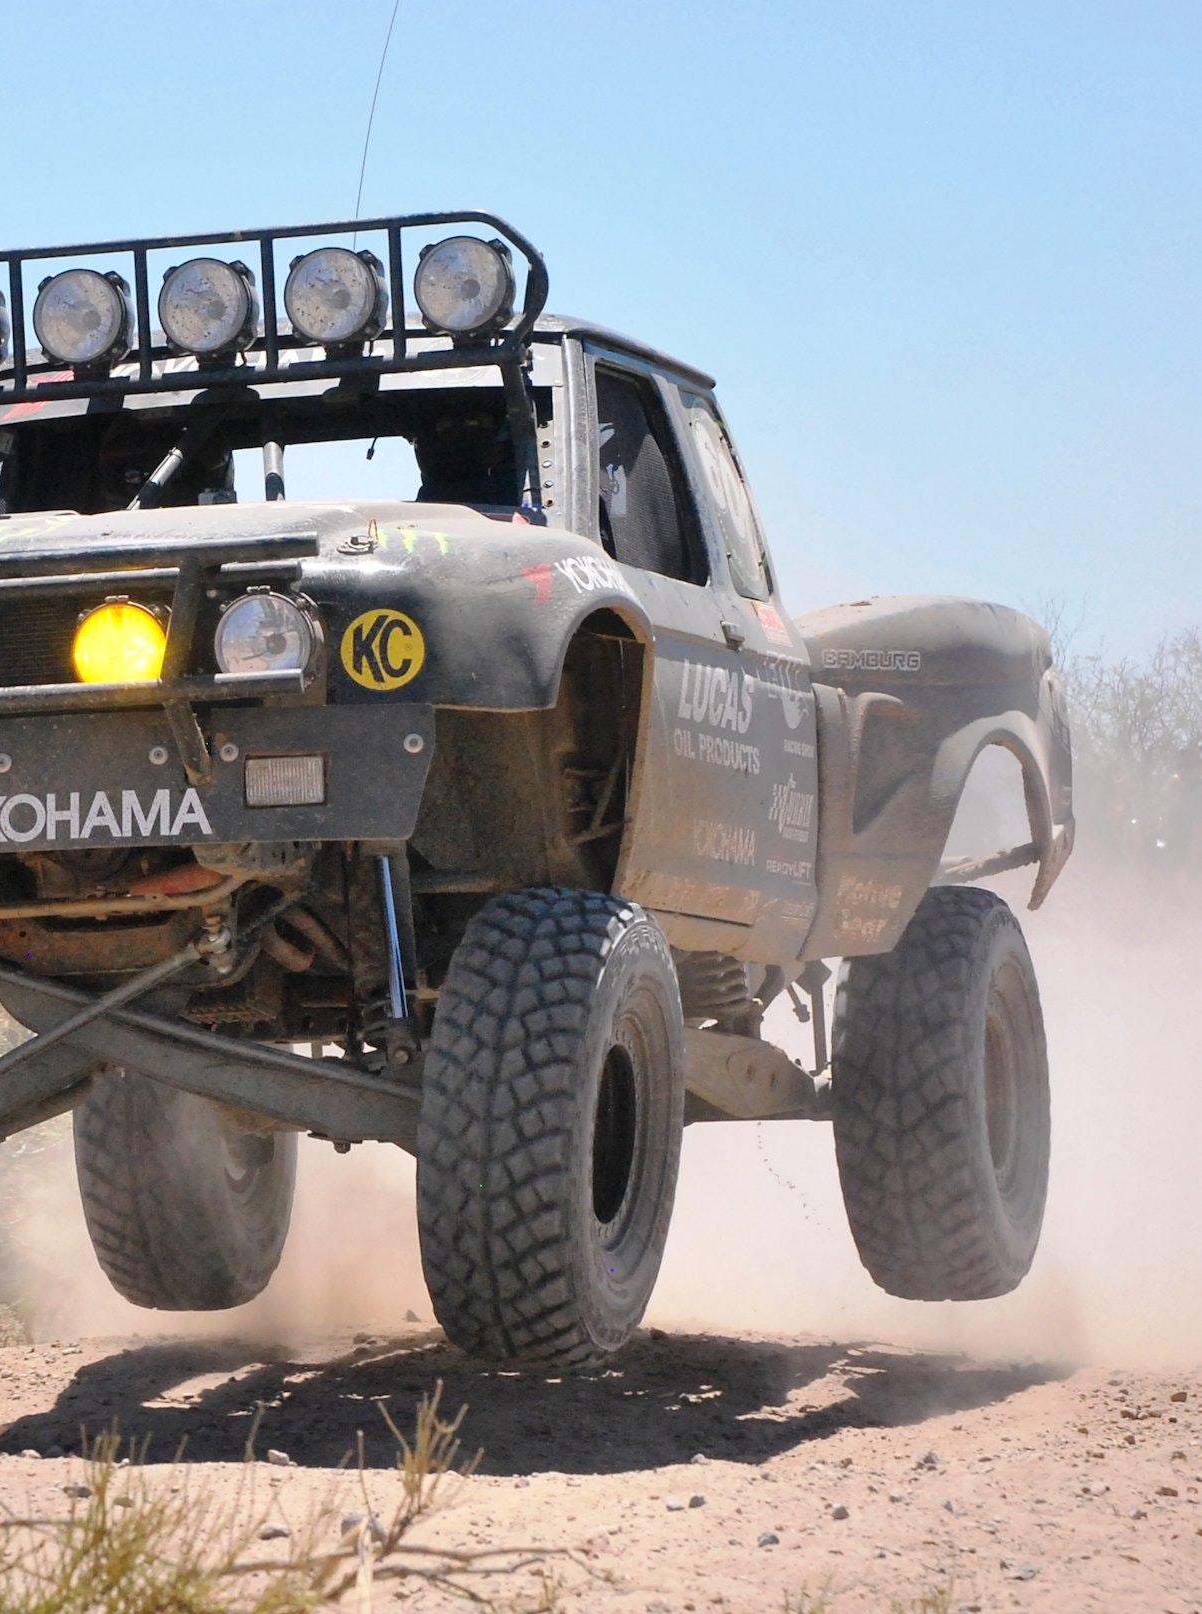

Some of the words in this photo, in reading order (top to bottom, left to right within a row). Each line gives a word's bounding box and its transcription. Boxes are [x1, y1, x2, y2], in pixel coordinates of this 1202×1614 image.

[353, 614, 412, 683] KC
[821, 648, 921, 672] CAMBURG
[677, 658, 755, 734] LUCAS
[673, 727, 696, 760] OIL
[698, 733, 761, 775] PRODUCTS
[766, 859, 813, 879] READYLIFT
